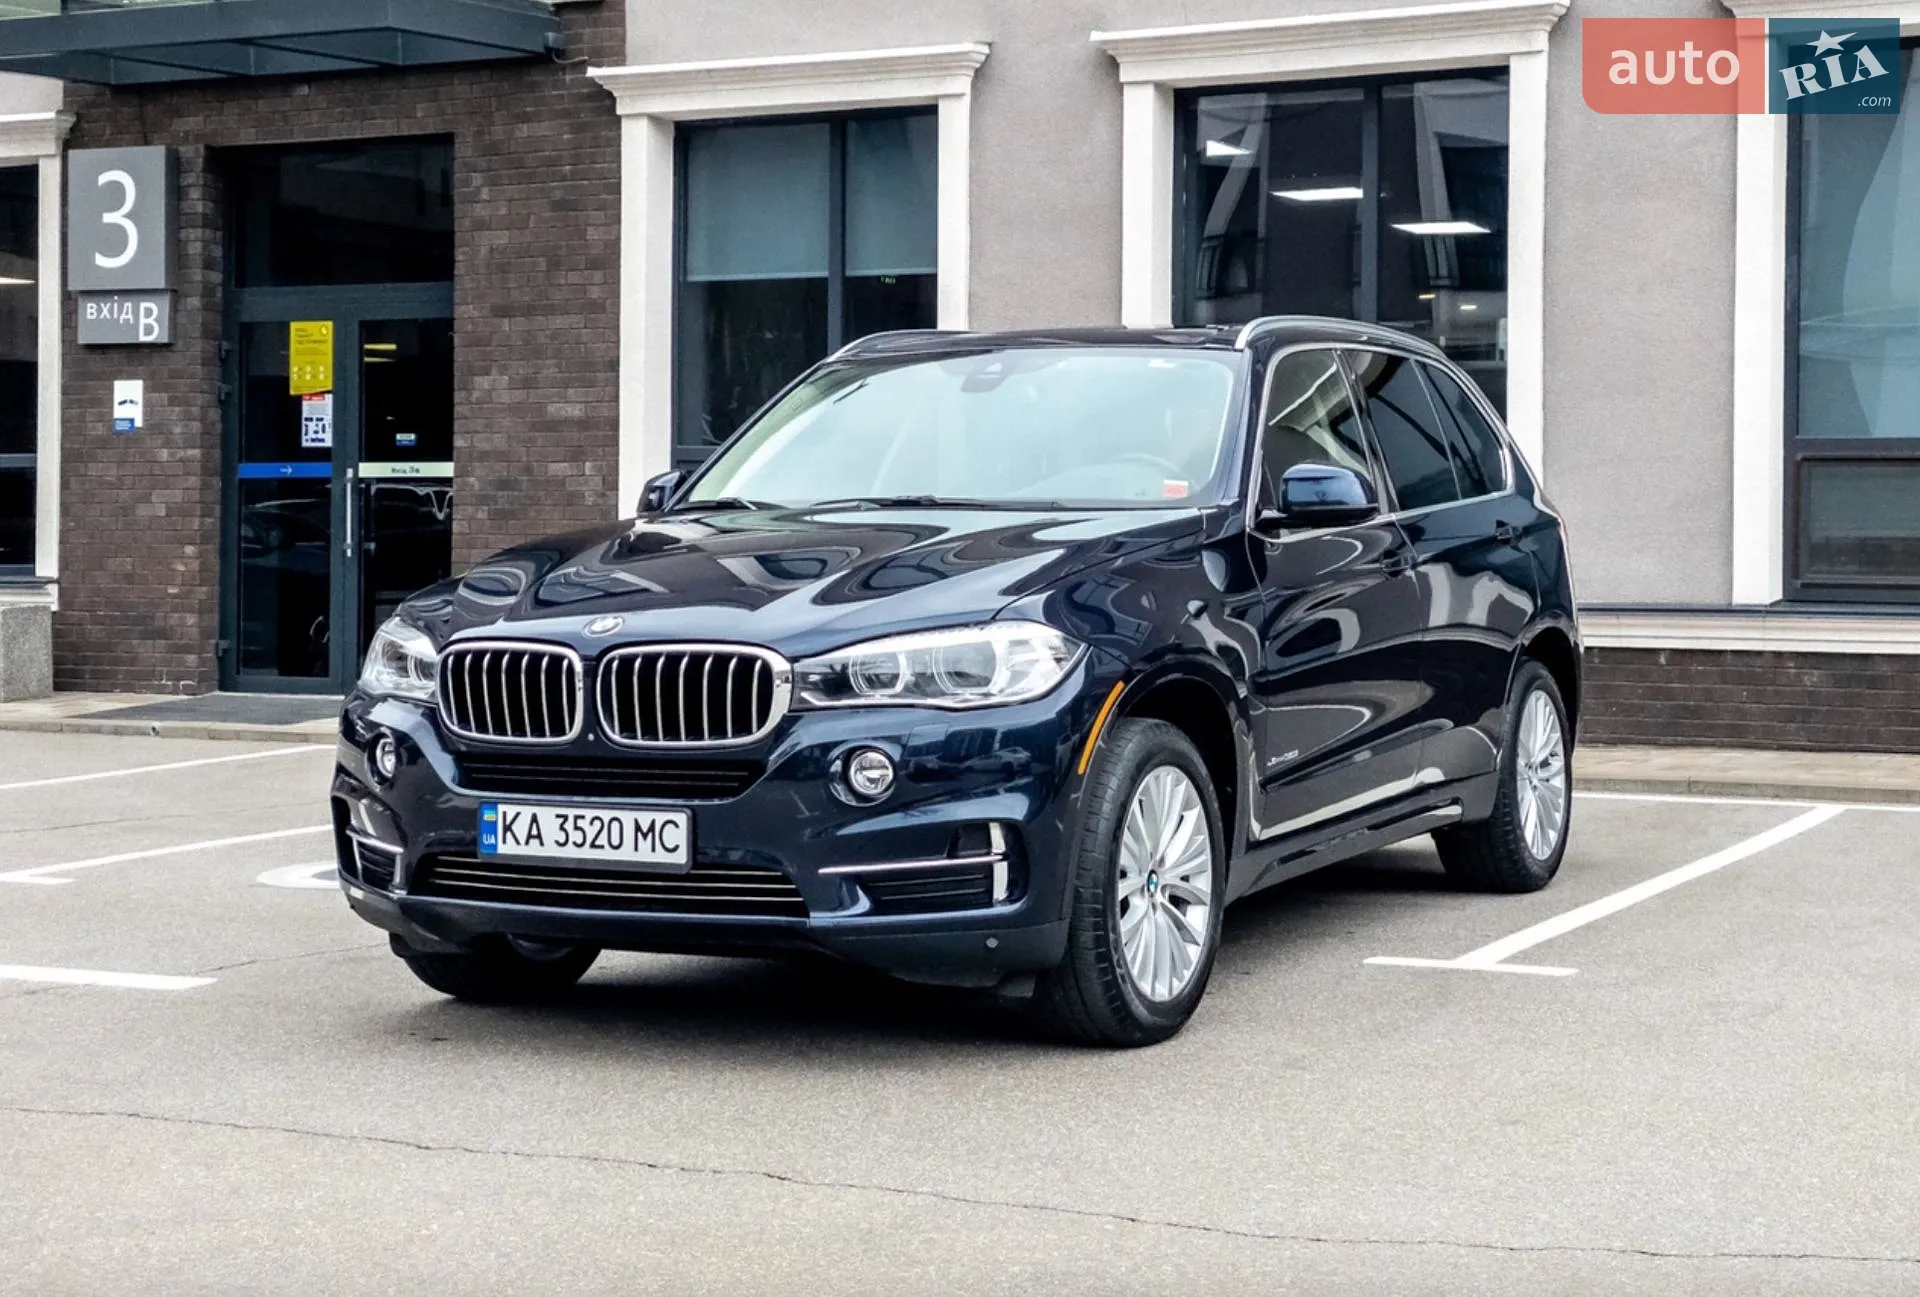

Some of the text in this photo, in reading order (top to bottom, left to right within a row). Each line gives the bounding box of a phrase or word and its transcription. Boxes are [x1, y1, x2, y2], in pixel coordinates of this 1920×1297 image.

[95, 169, 139, 269] 3
[86, 296, 134, 324] вхід
[482, 833, 496, 845] UA
[501, 811, 681, 853] KA 3520 MC
